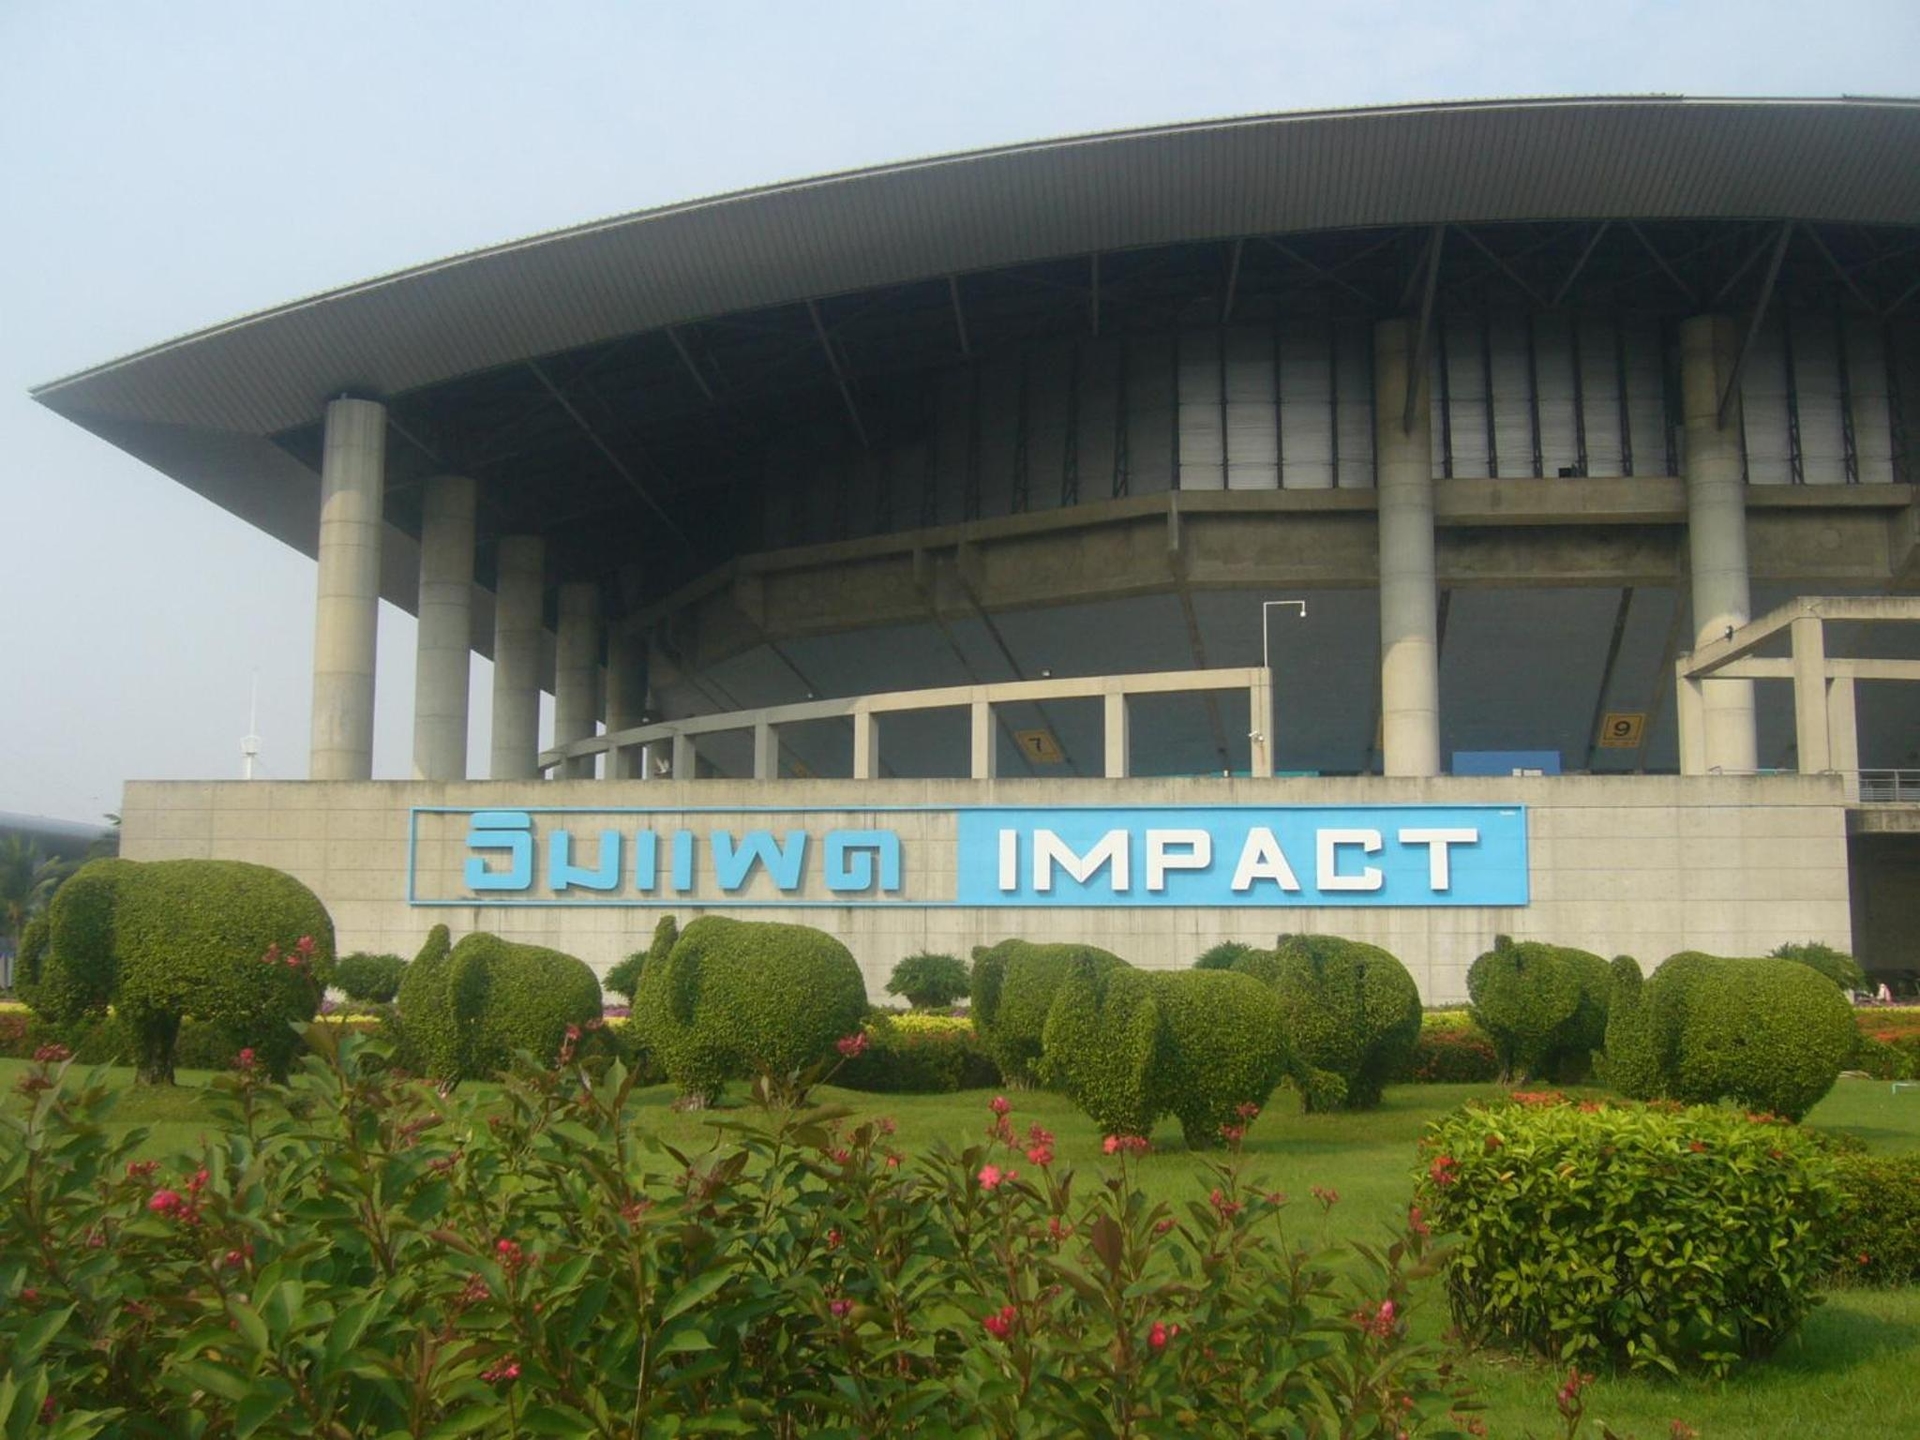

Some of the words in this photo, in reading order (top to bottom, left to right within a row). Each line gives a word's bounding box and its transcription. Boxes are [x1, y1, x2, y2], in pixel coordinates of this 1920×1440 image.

[1614, 720, 1631, 736] 9
[1027, 737, 1042, 753] 7
[999, 827, 1479, 891] IMPACT
